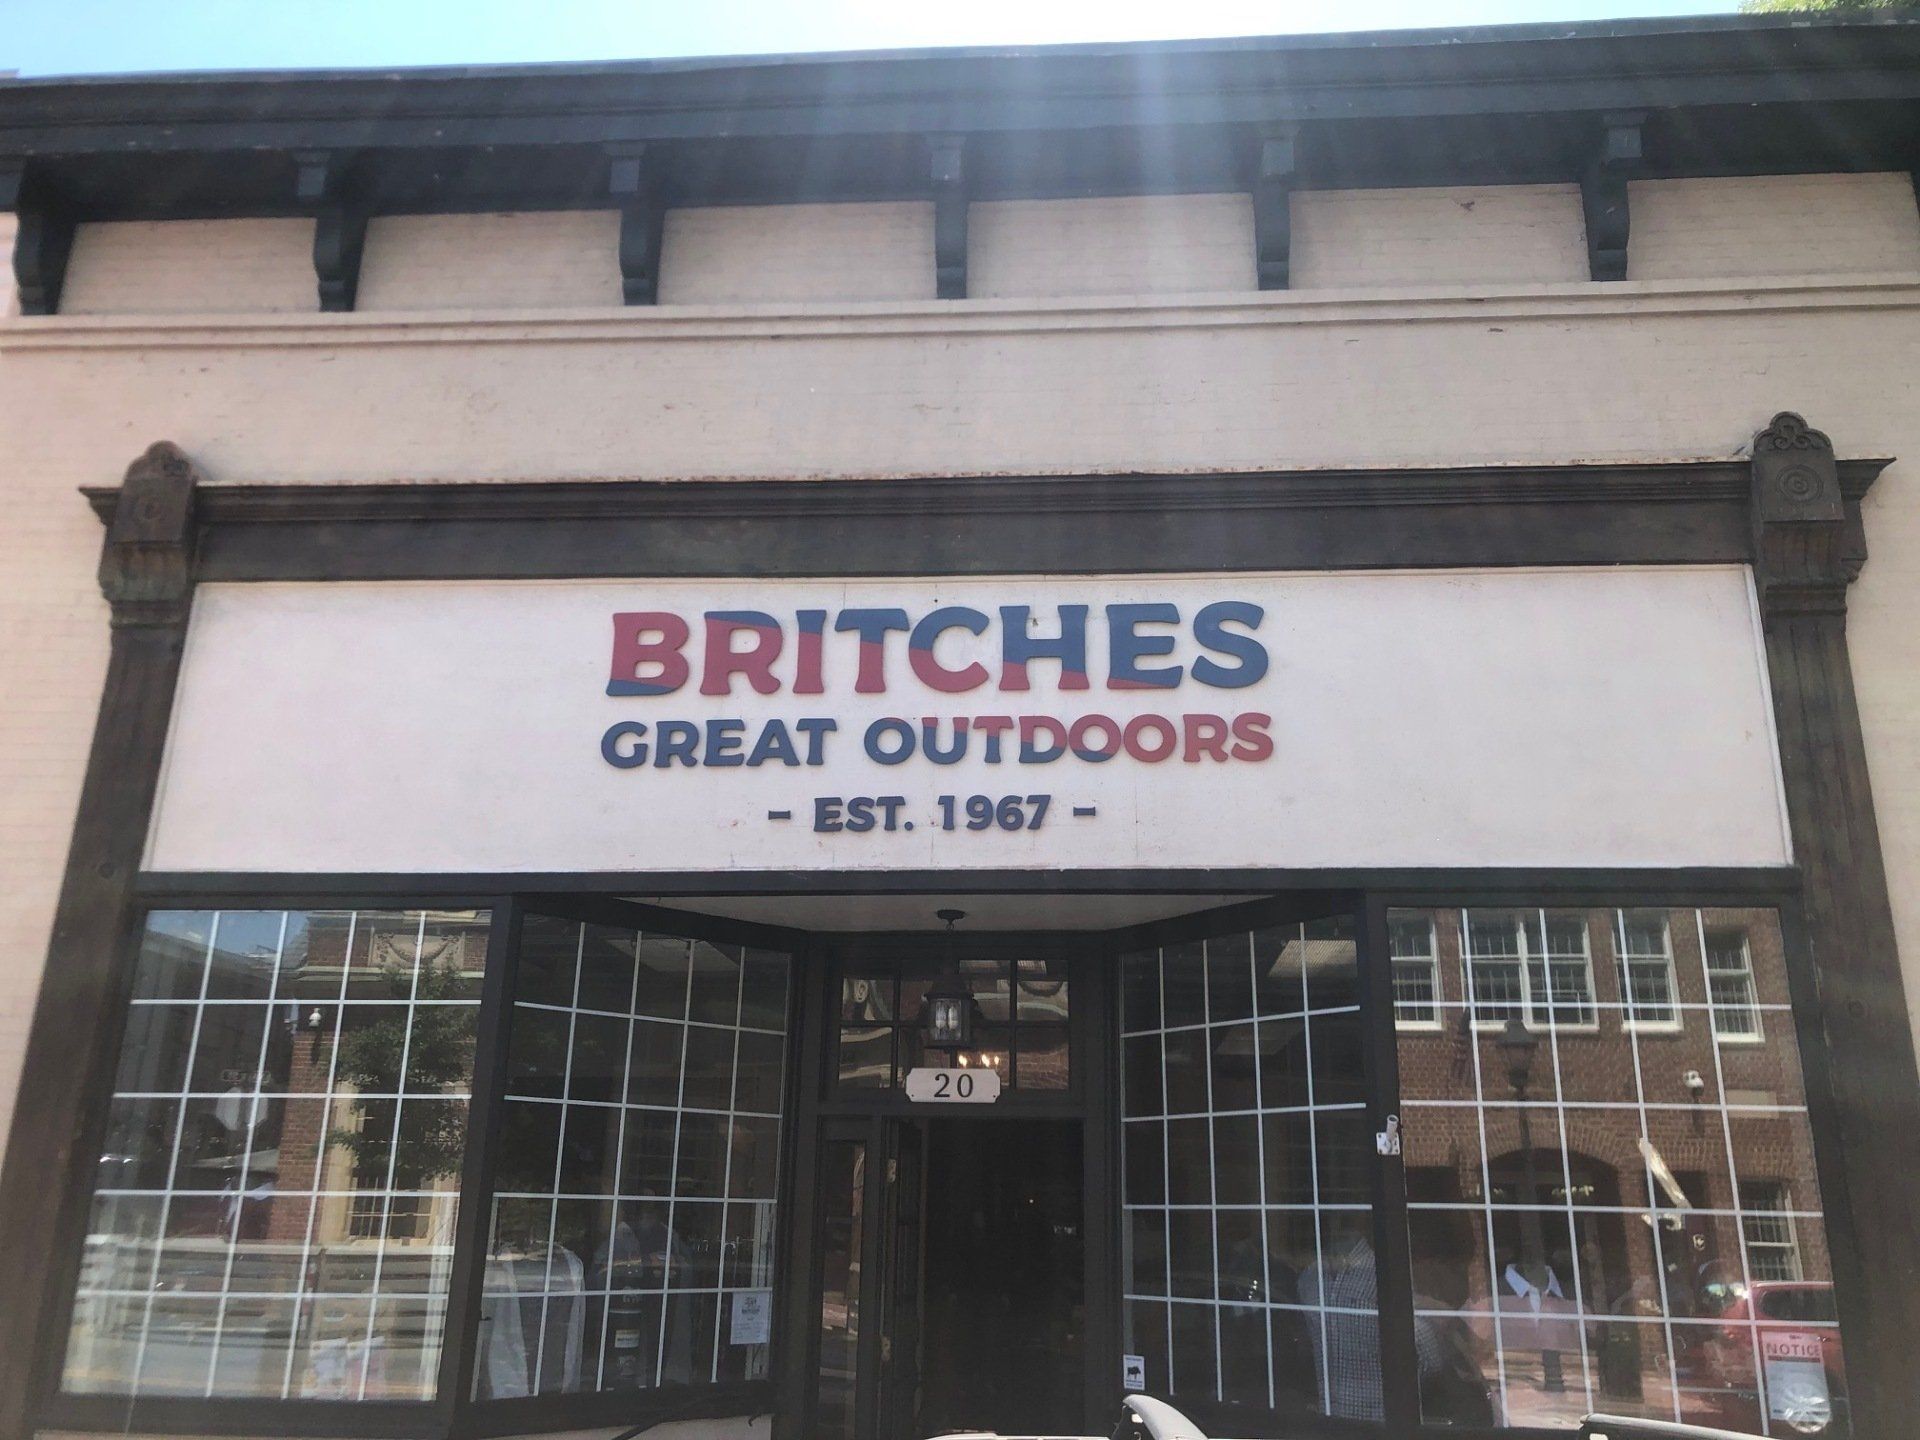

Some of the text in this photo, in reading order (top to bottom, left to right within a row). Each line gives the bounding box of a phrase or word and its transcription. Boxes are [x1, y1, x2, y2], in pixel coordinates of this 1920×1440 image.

[605, 600, 1269, 697] BRITCHES
[600, 712, 1274, 769] GREAT OUTDOORS
[813, 796, 915, 833] EST.
[937, 794, 1052, 832] 1967
[933, 1073, 974, 1098] 20
[1765, 1343, 1821, 1357] NOTICE
